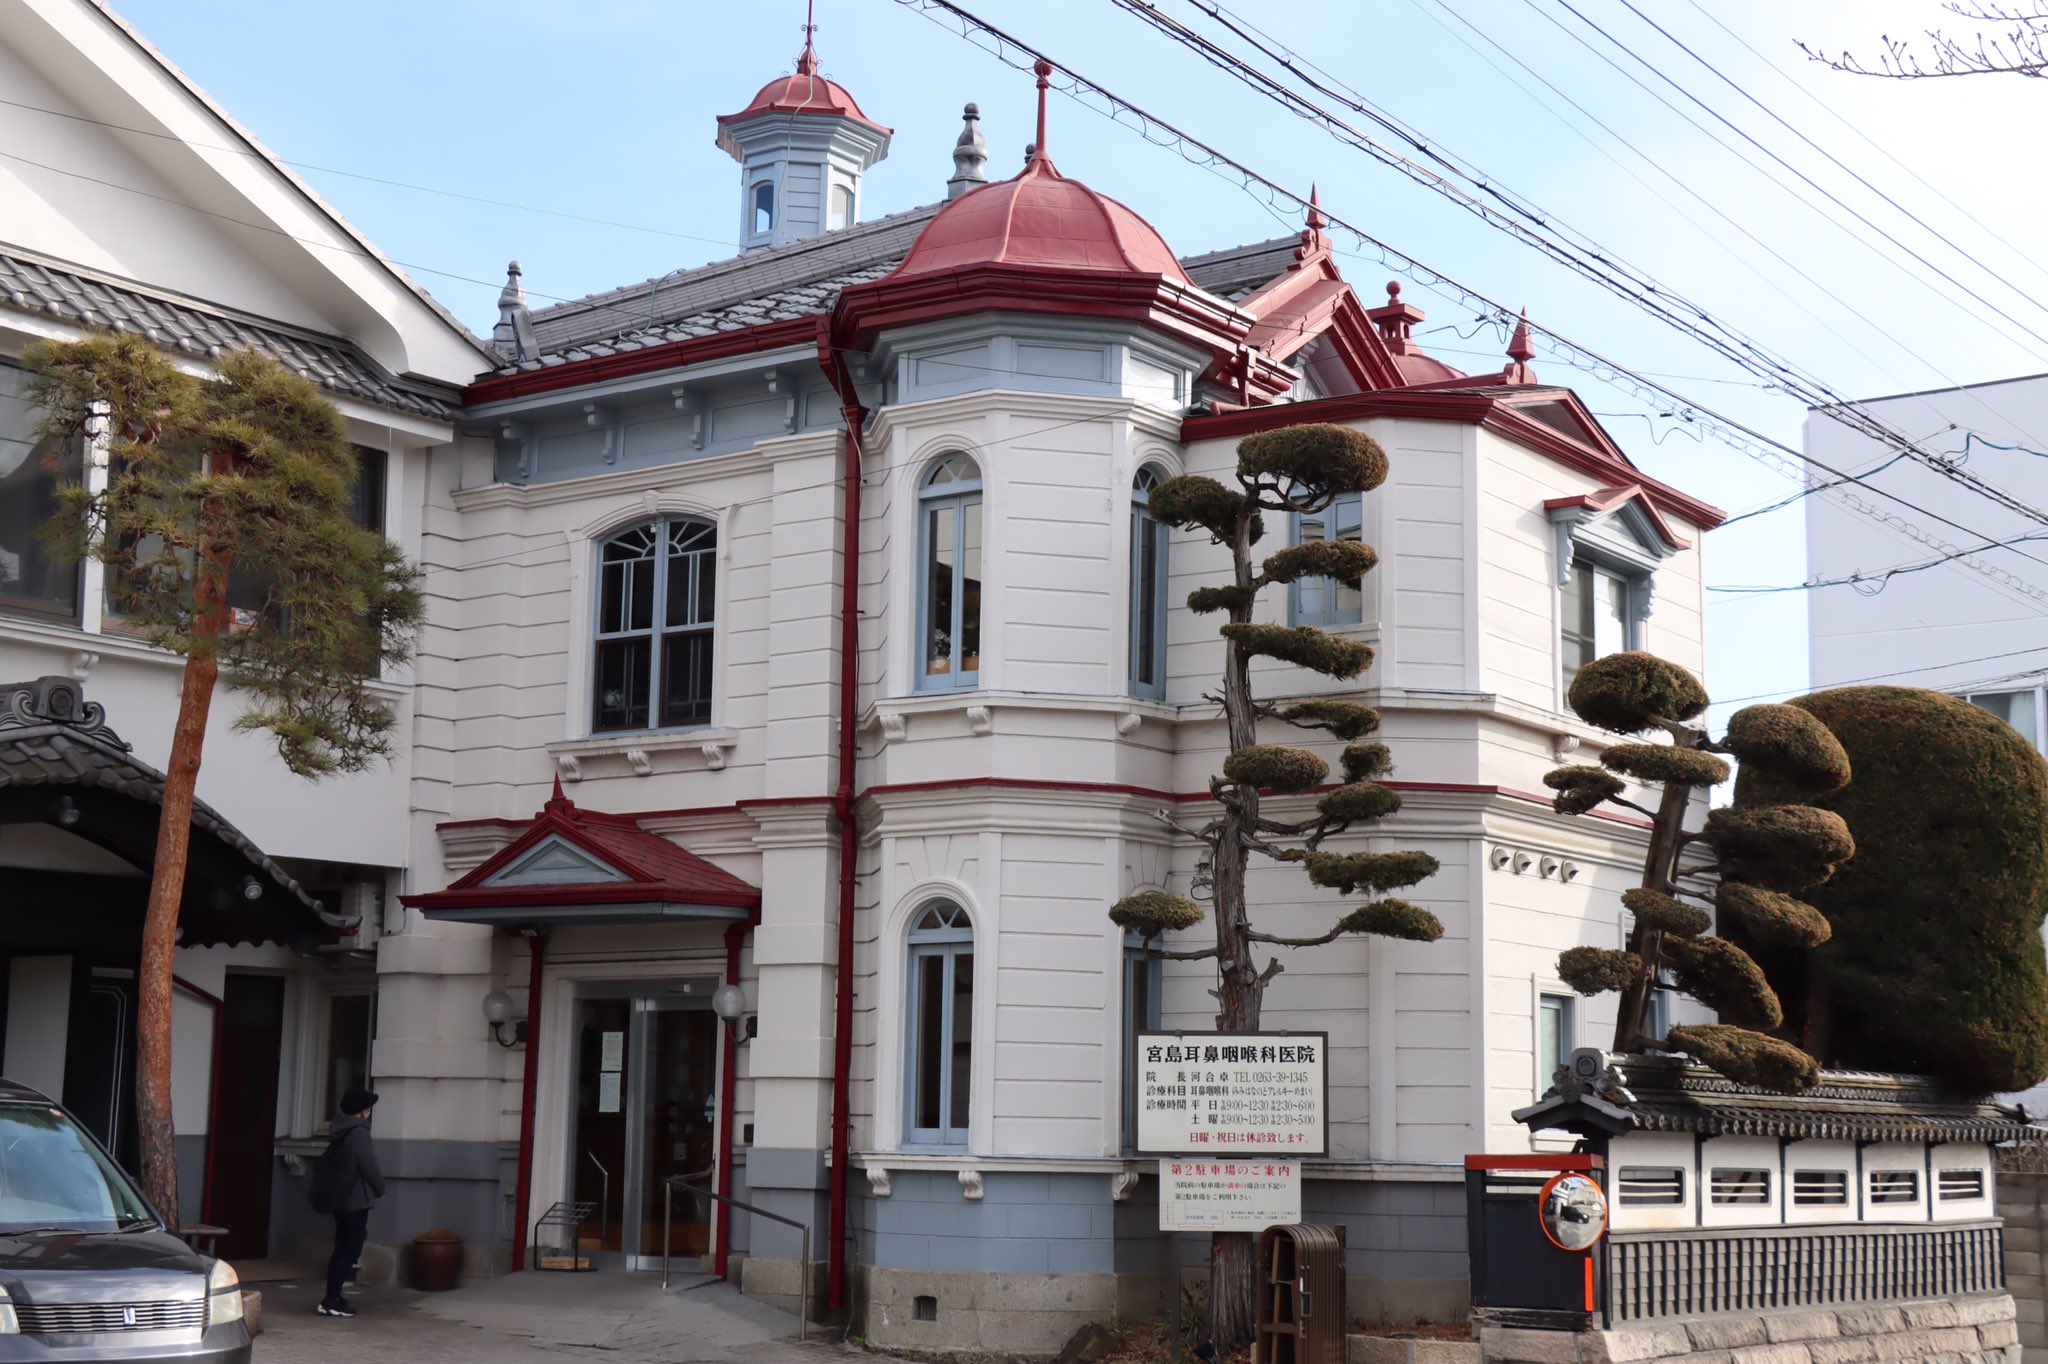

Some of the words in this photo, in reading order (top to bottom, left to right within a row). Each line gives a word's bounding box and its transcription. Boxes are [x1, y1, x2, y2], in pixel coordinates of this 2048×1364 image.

[1146, 1045, 1315, 1063] 宮島耳鼻咽喉科医院
[1233, 1071, 1251, 1083] TEL
[1252, 1071, 1308, 1083] 0263-39-1345
[1146, 1085, 1186, 1096] 診療科目
[1190, 1085, 1229, 1096] 耳鼻咽喉科
[1146, 1099, 1187, 1110] 診療時間
[1171, 1164, 1290, 1177] 第2駐車場のご案内
